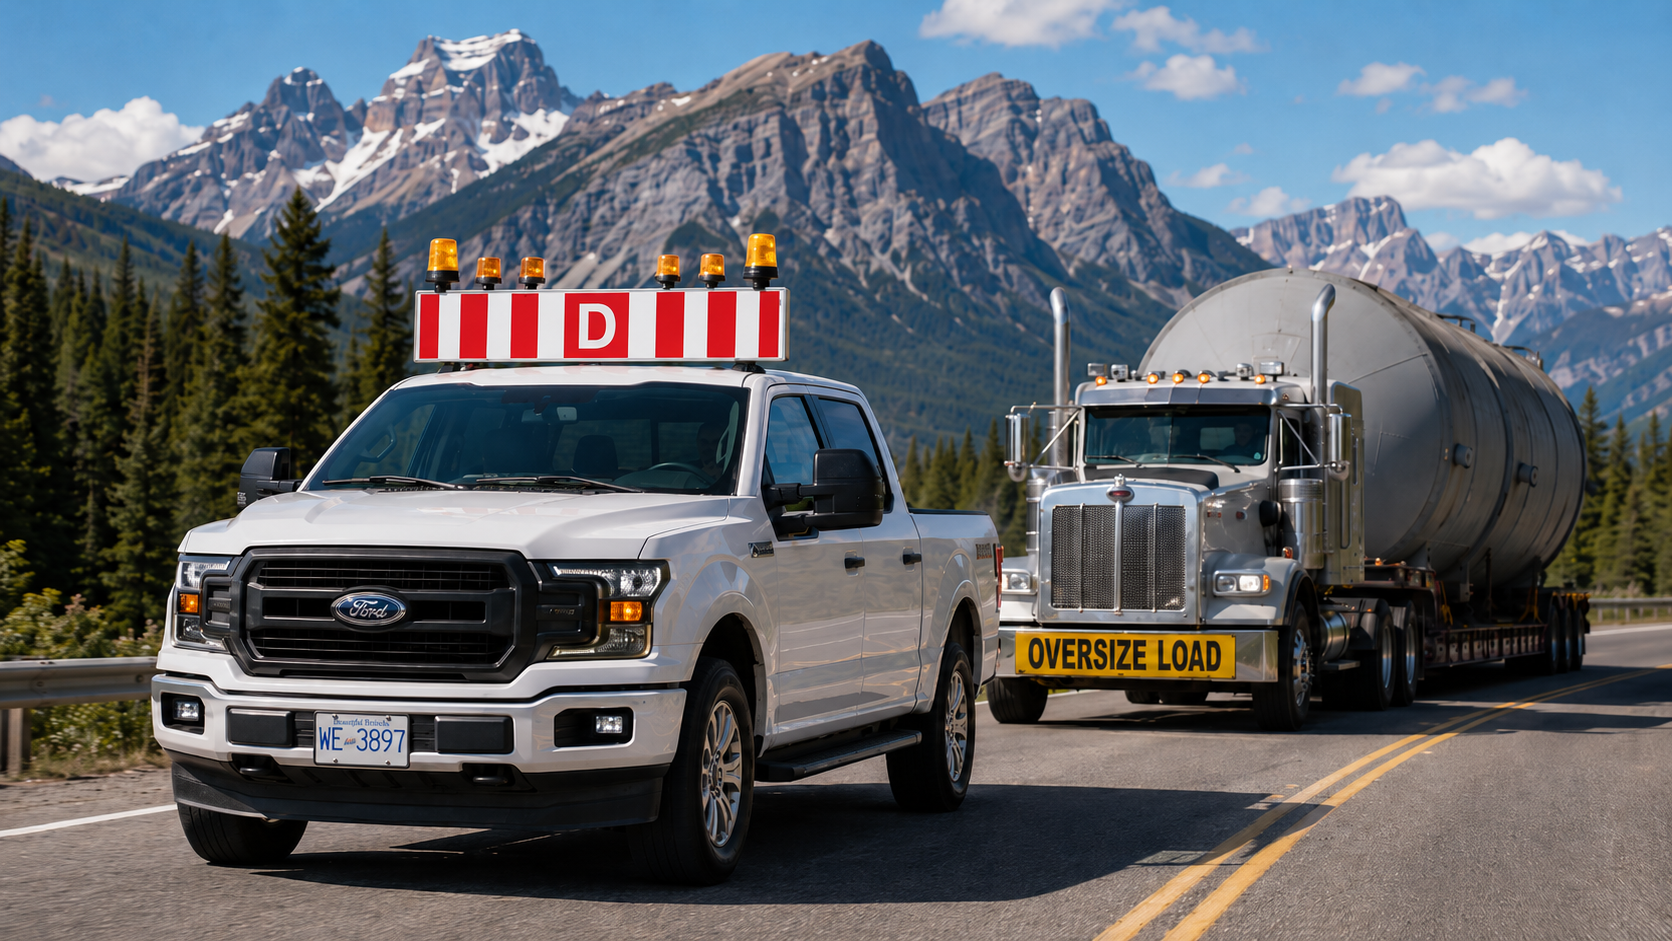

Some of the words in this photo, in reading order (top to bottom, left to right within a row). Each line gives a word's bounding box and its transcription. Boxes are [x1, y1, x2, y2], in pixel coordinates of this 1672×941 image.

[579, 303, 616, 349] D
[349, 599, 389, 618] Ford
[1028, 637, 1147, 670] OVERSIZE
[1157, 639, 1222, 671] LOAD
[319, 727, 343, 751] WE
[356, 728, 406, 753] 3897
